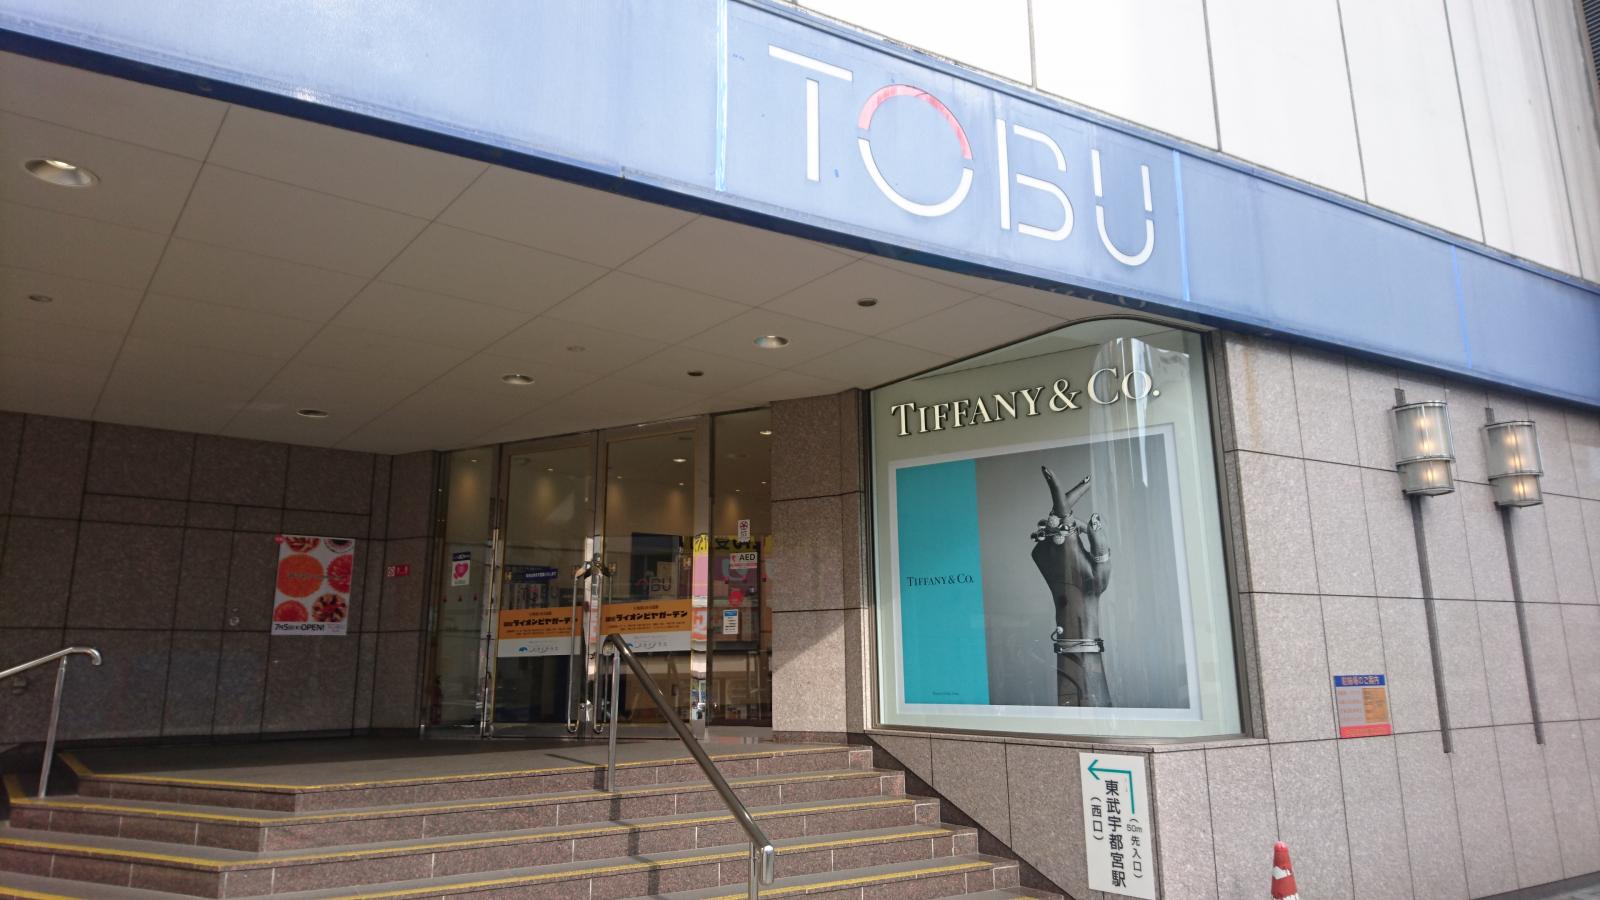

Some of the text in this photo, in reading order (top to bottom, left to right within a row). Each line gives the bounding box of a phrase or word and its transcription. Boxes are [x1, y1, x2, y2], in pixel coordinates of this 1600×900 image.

[768, 44, 1155, 267] TOBU
[891, 386, 1044, 437] TIFFANY
[1049, 378, 1081, 412] &
[739, 553, 756, 561] AED
[906, 576, 947, 587] TIFFANY
[947, 575, 956, 585] &
[1090, 796, 1105, 841] (西口)
[1104, 780, 1127, 889] 東武宇都宮駅
